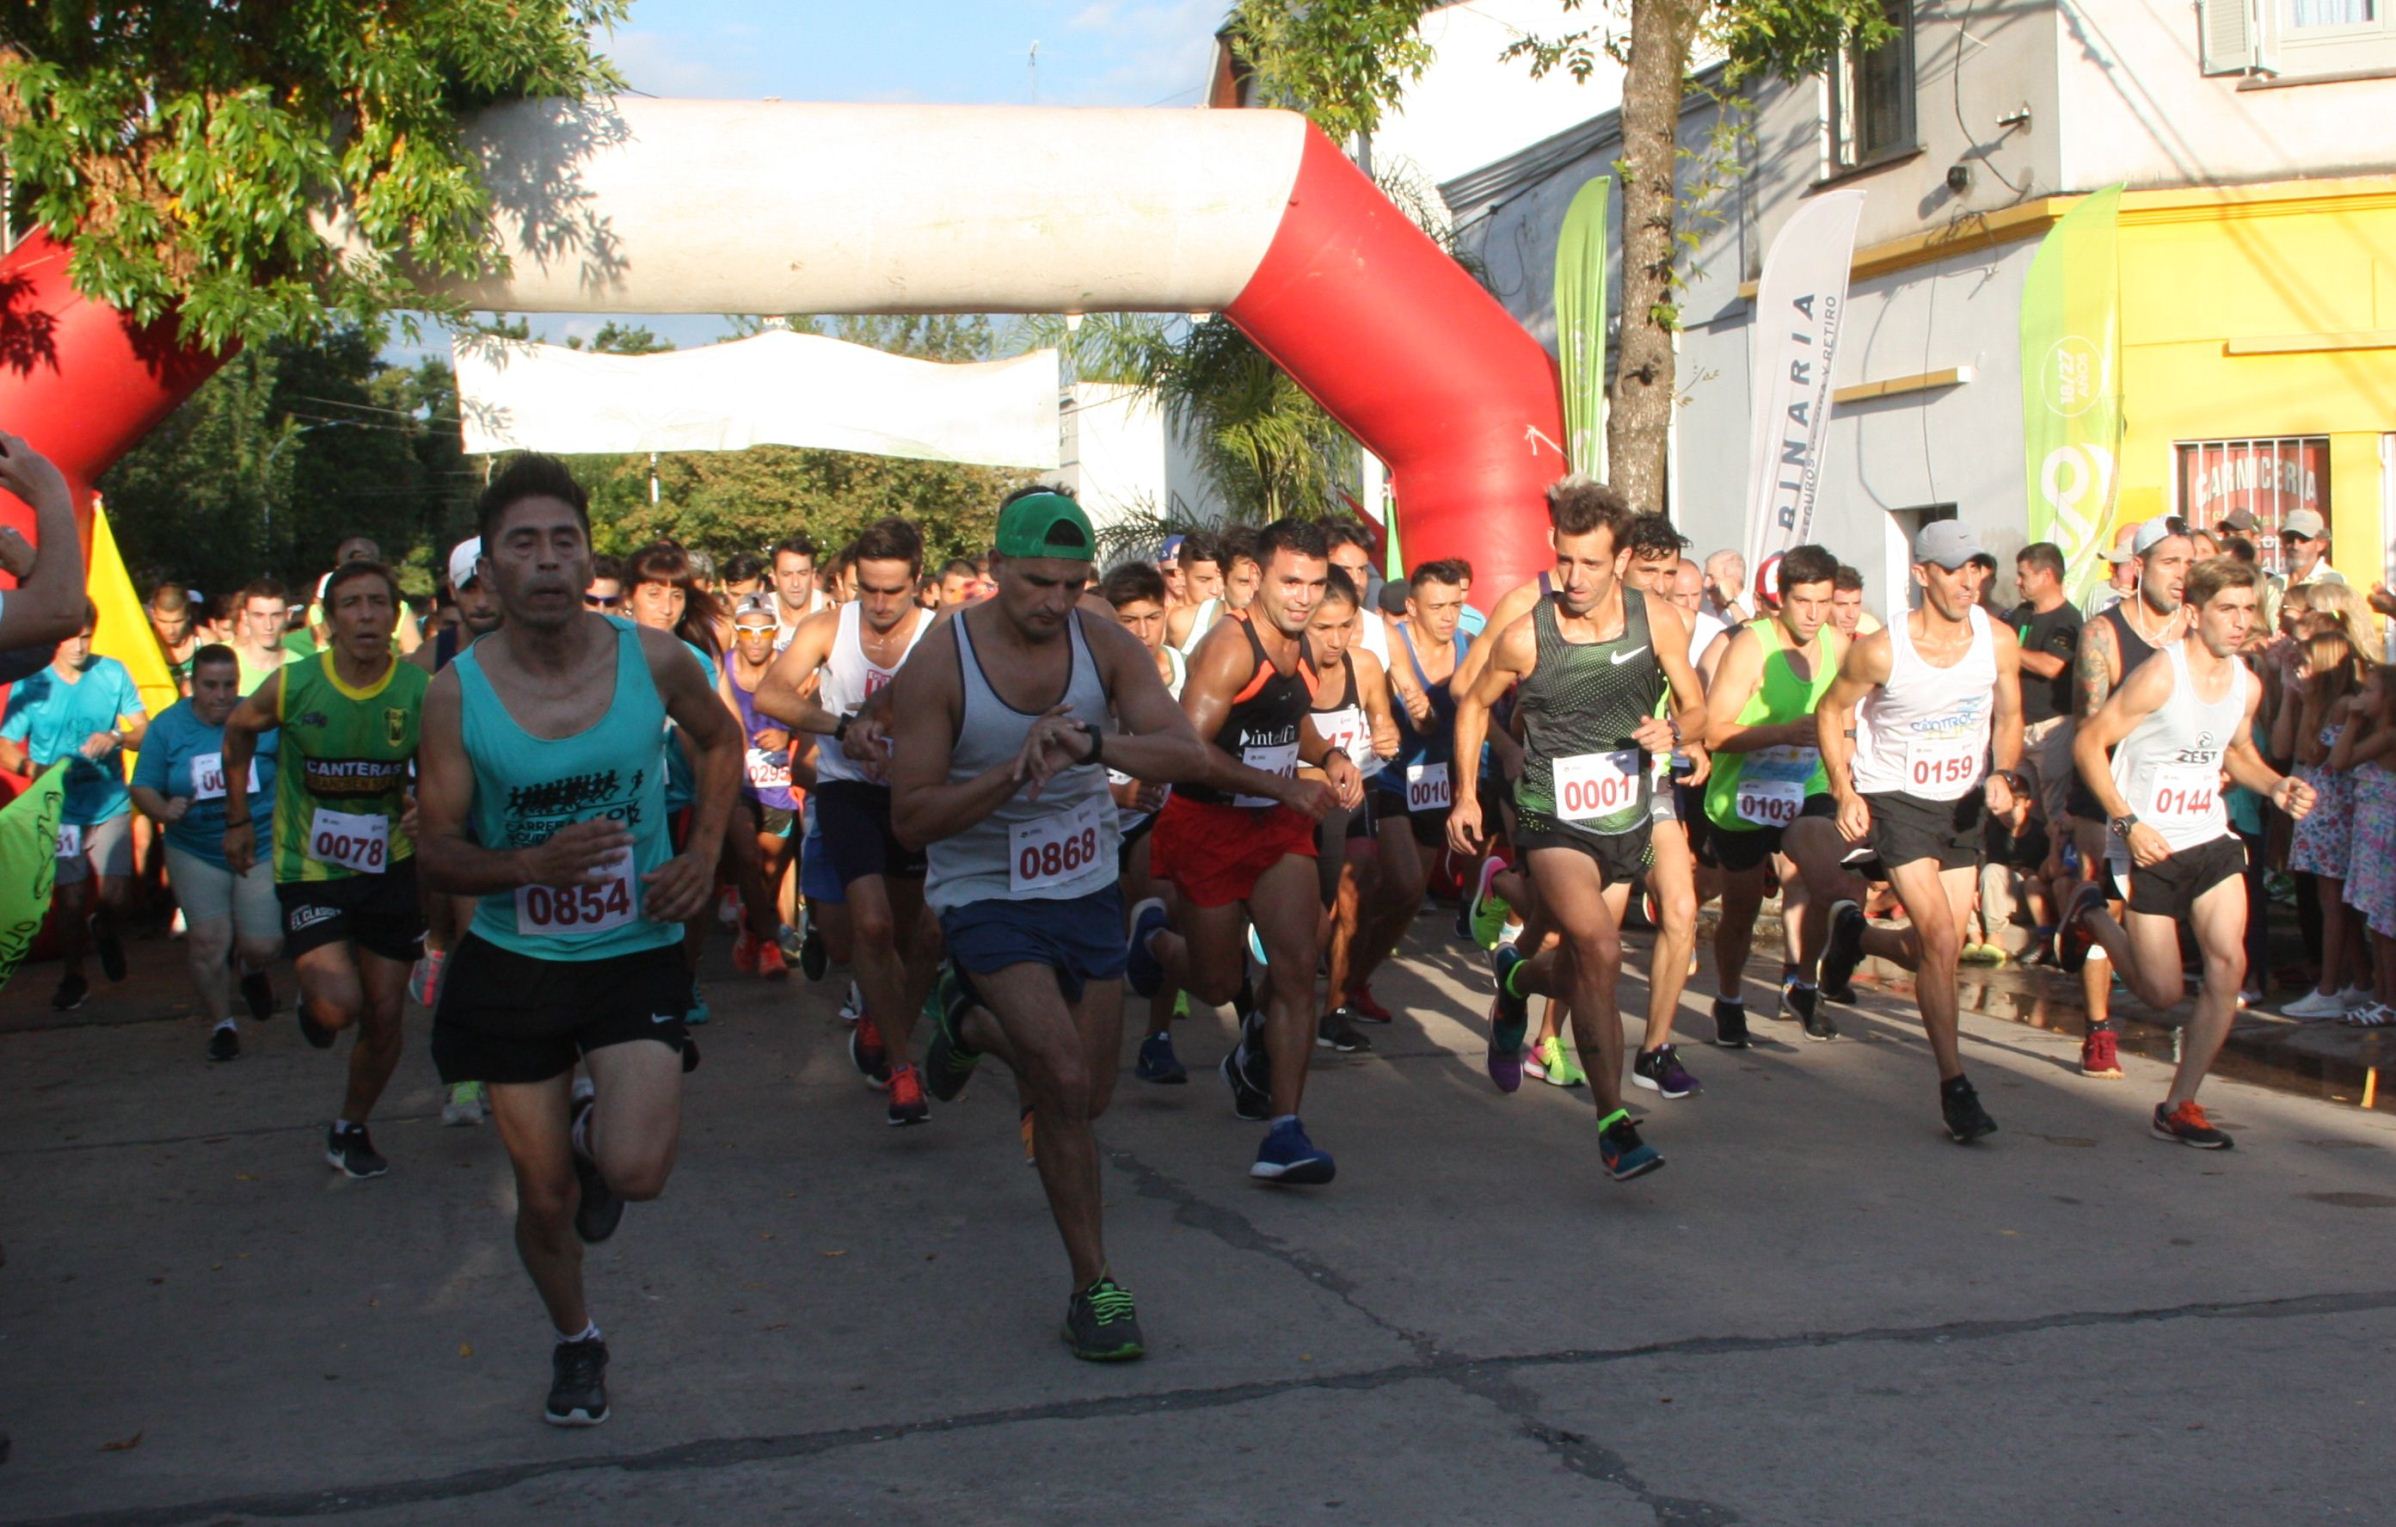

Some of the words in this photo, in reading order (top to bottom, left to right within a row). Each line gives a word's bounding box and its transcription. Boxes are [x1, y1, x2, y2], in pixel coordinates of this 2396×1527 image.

[1822, 296, 1837, 361] RETIRO
[306, 760, 402, 777] CANTERAS
[1913, 754, 1973, 785] 0159
[2176, 749, 2218, 764] ZEST
[1411, 780, 1449, 806] 0010
[1564, 773, 1630, 812] 0001
[1742, 795, 1796, 821] 0103
[2155, 787, 2212, 815] 0144
[316, 831, 384, 867] 0078
[1020, 827, 1096, 881] 0868
[526, 877, 630, 926] 0854
